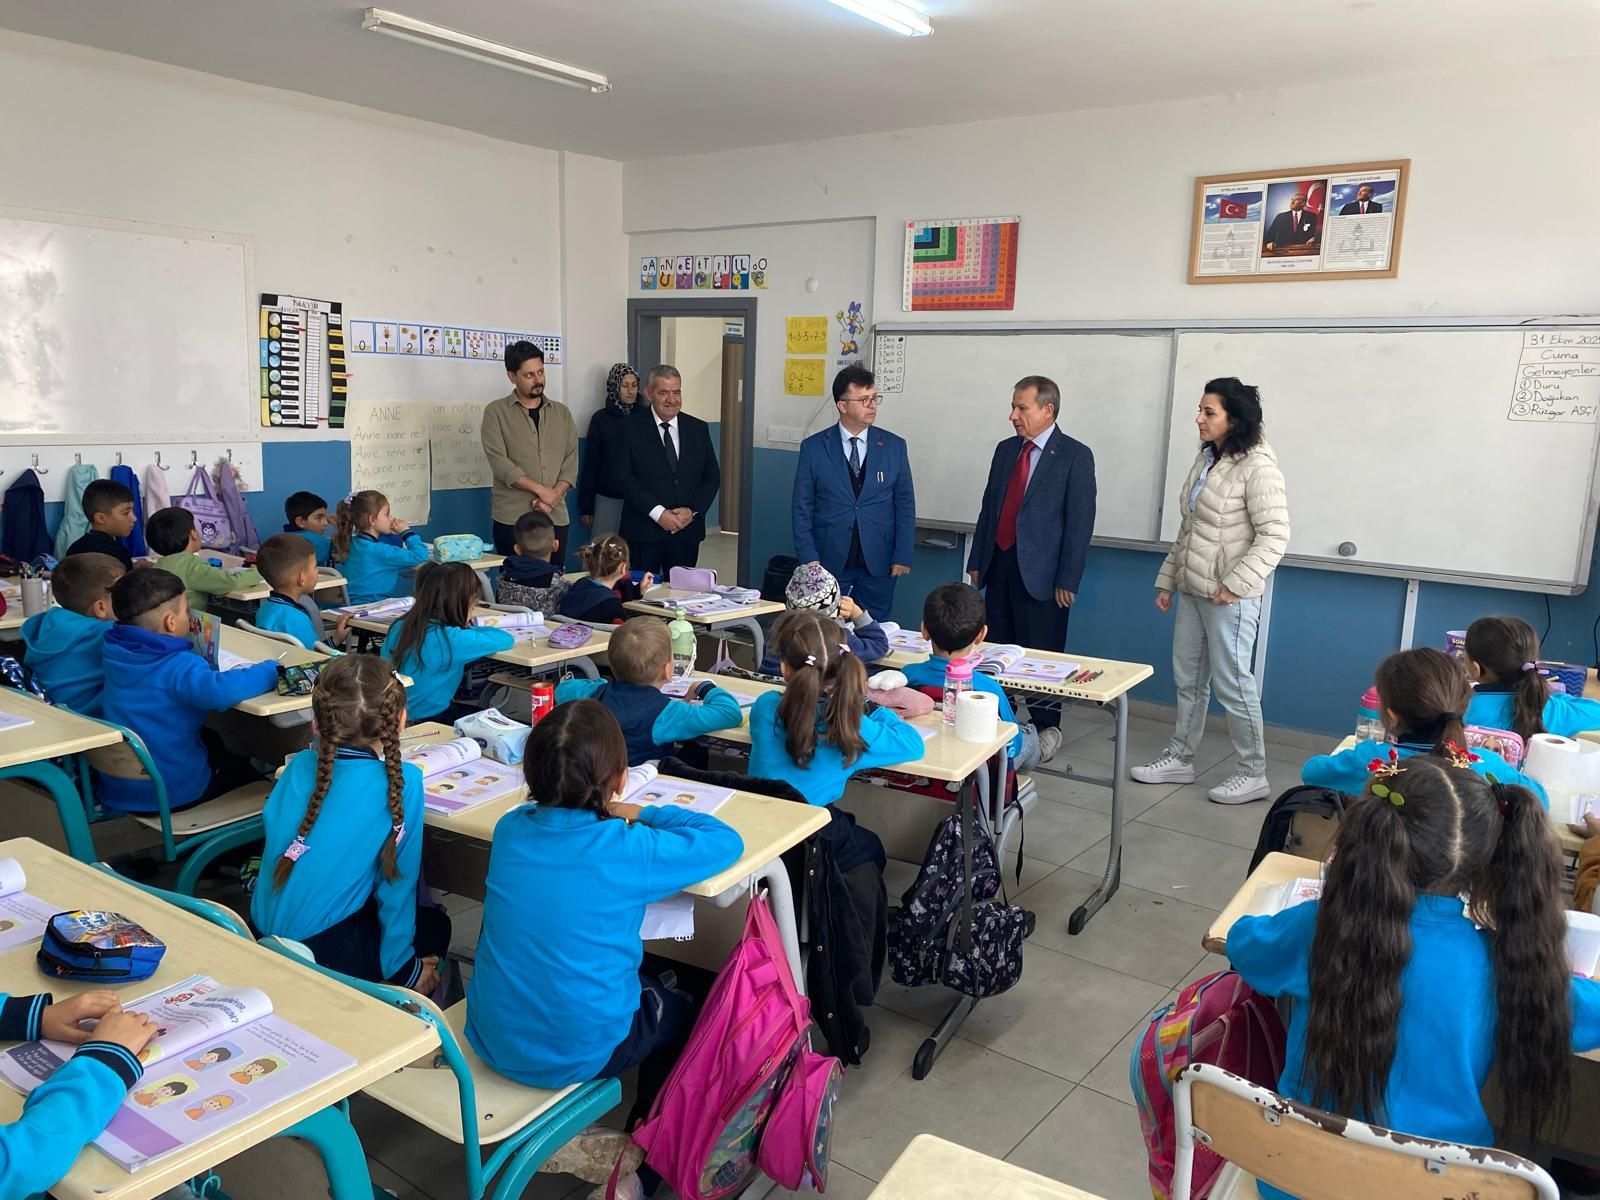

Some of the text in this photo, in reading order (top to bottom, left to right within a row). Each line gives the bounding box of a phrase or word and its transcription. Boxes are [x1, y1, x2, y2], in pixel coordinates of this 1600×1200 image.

[1530, 334, 1545, 345] 31
[359, 340, 554, 361] 0 1 2 3 4 5 6 9
[1540, 349, 1579, 360] Cuma
[1522, 363, 1597, 379] Gelmeyenler
[1534, 379, 1560, 389] Duru
